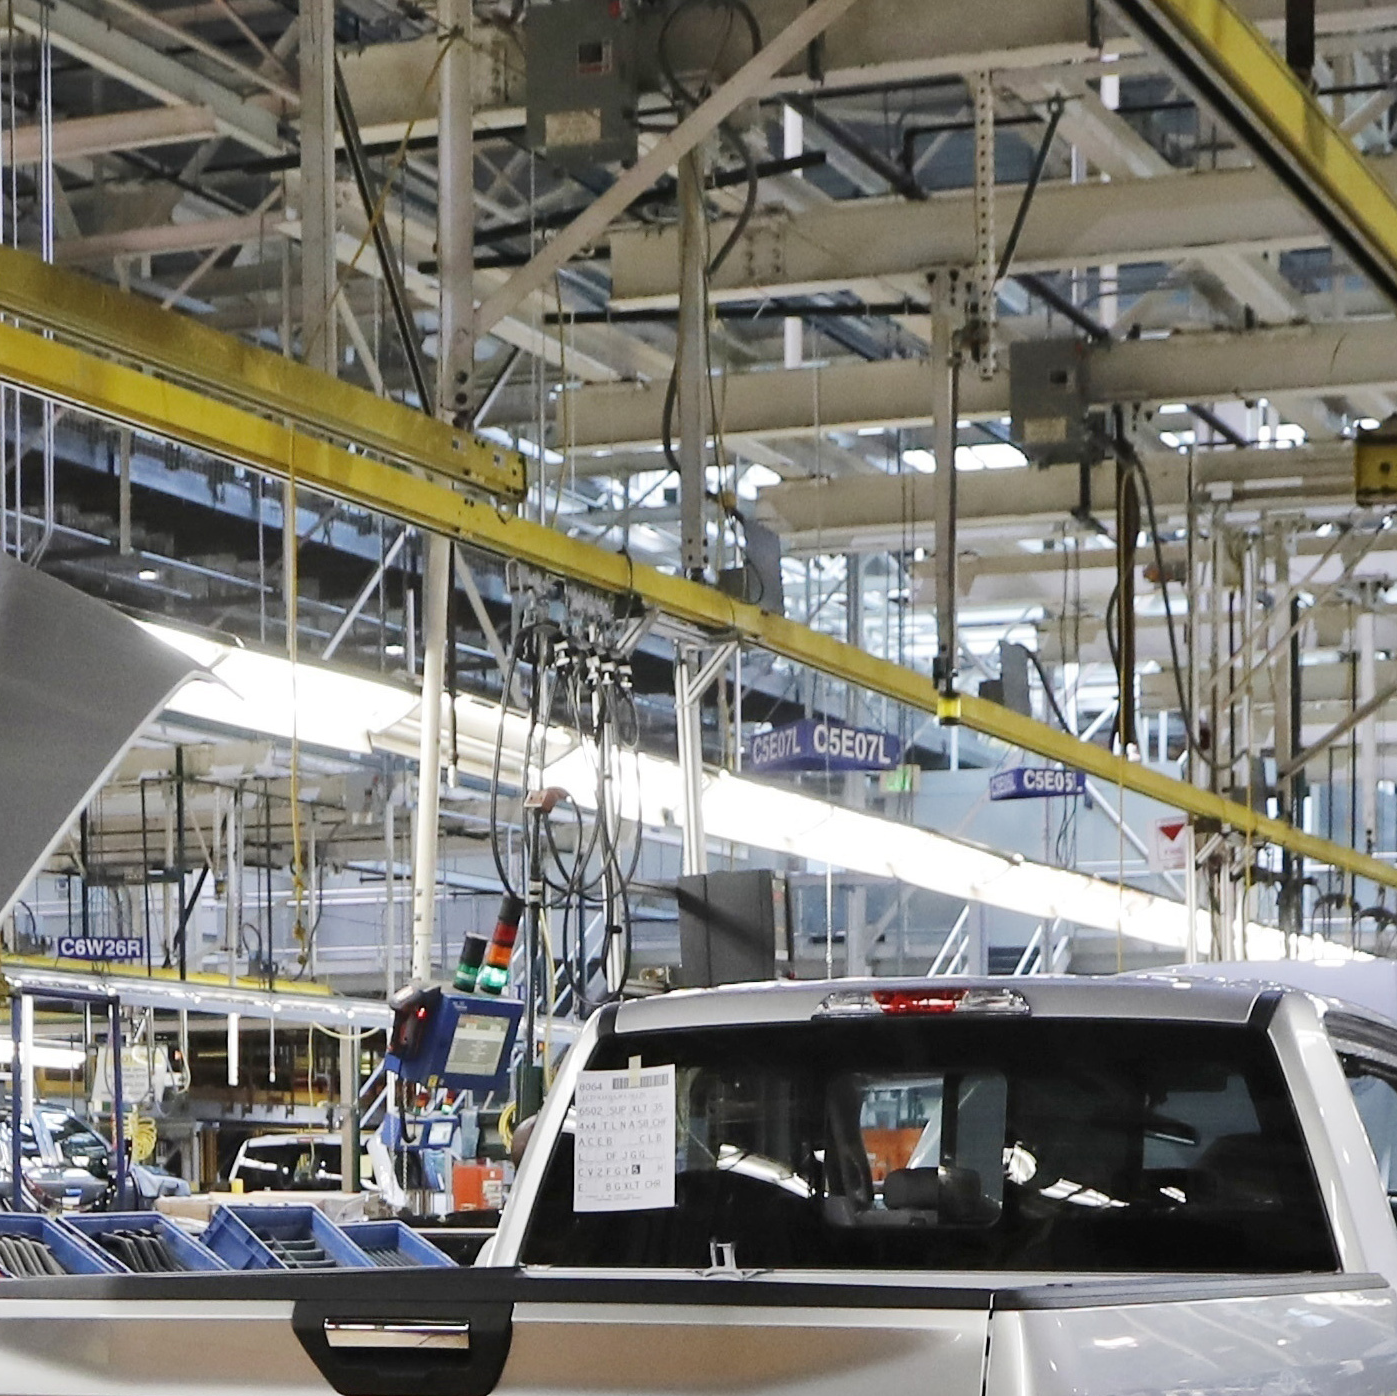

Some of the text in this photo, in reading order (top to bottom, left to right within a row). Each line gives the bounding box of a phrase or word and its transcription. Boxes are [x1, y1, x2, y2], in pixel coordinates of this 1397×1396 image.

[752, 725, 802, 765] C5E07L
[813, 723, 892, 765] C5E07L
[60, 937, 141, 957] C6W26R
